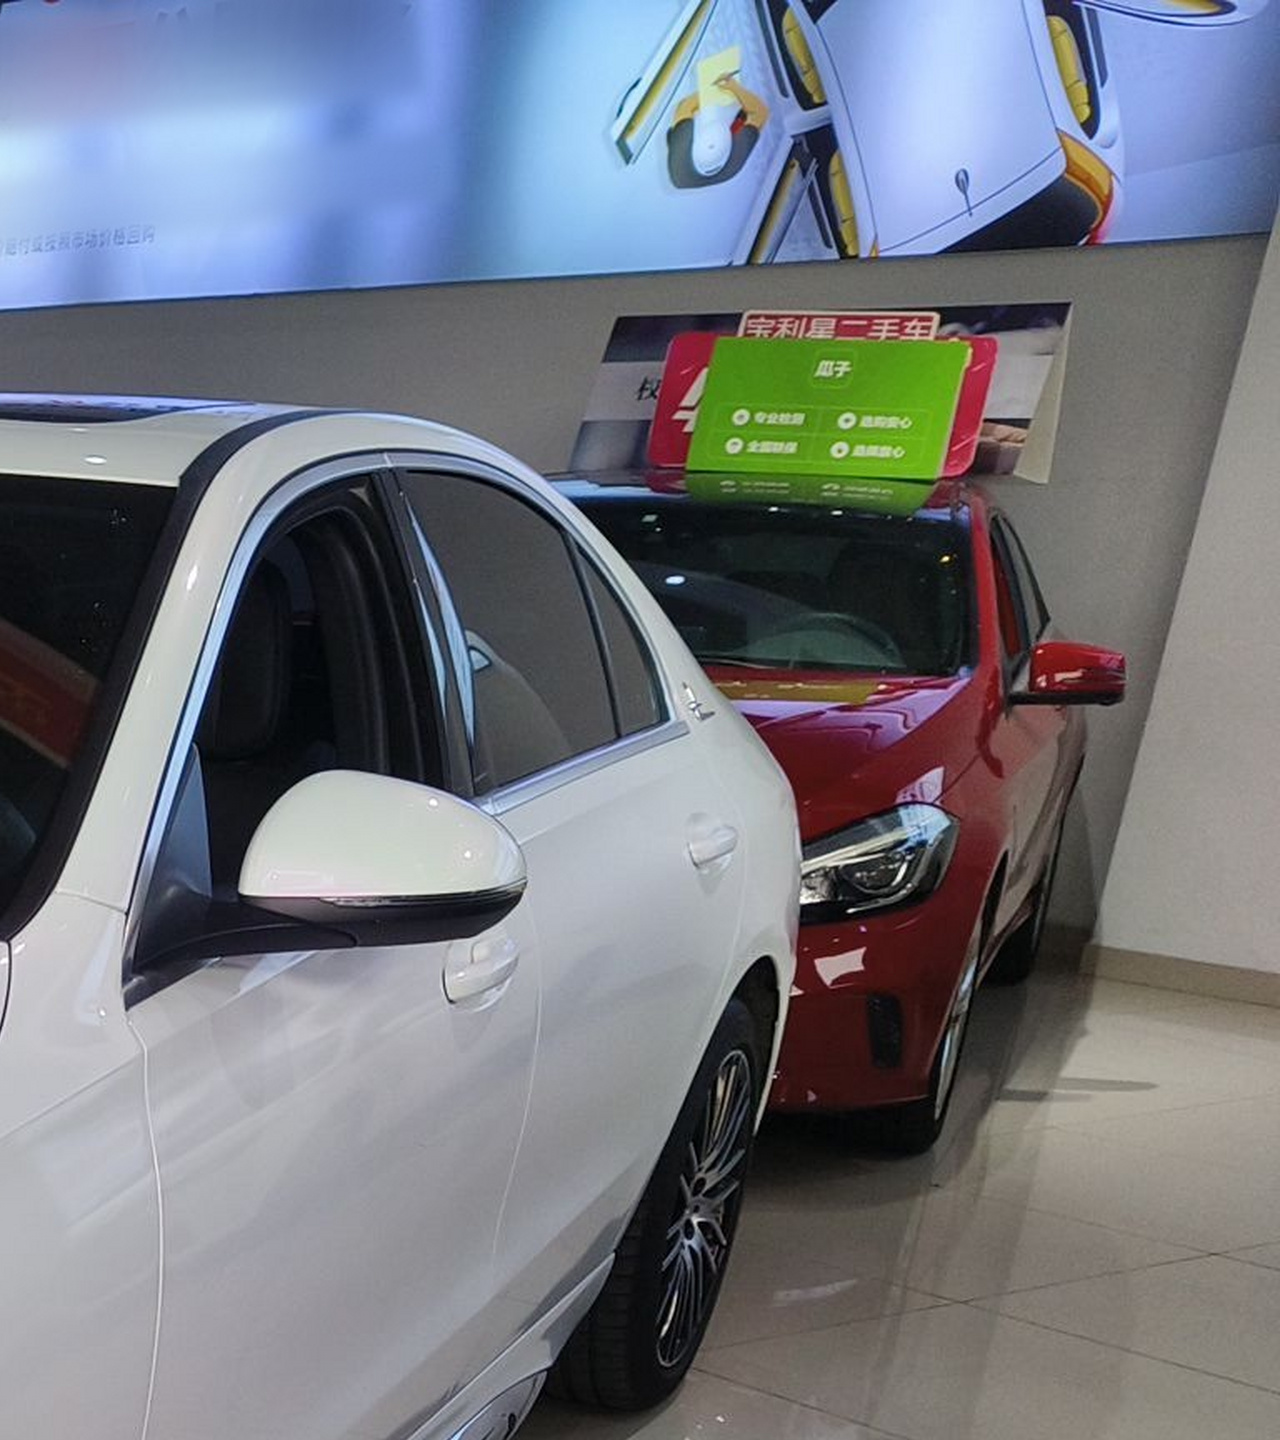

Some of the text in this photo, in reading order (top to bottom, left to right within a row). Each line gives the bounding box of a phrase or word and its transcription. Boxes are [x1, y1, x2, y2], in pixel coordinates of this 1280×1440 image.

[746, 316, 933, 339] 宝利星二手车
[813, 360, 853, 379] 瓜子
